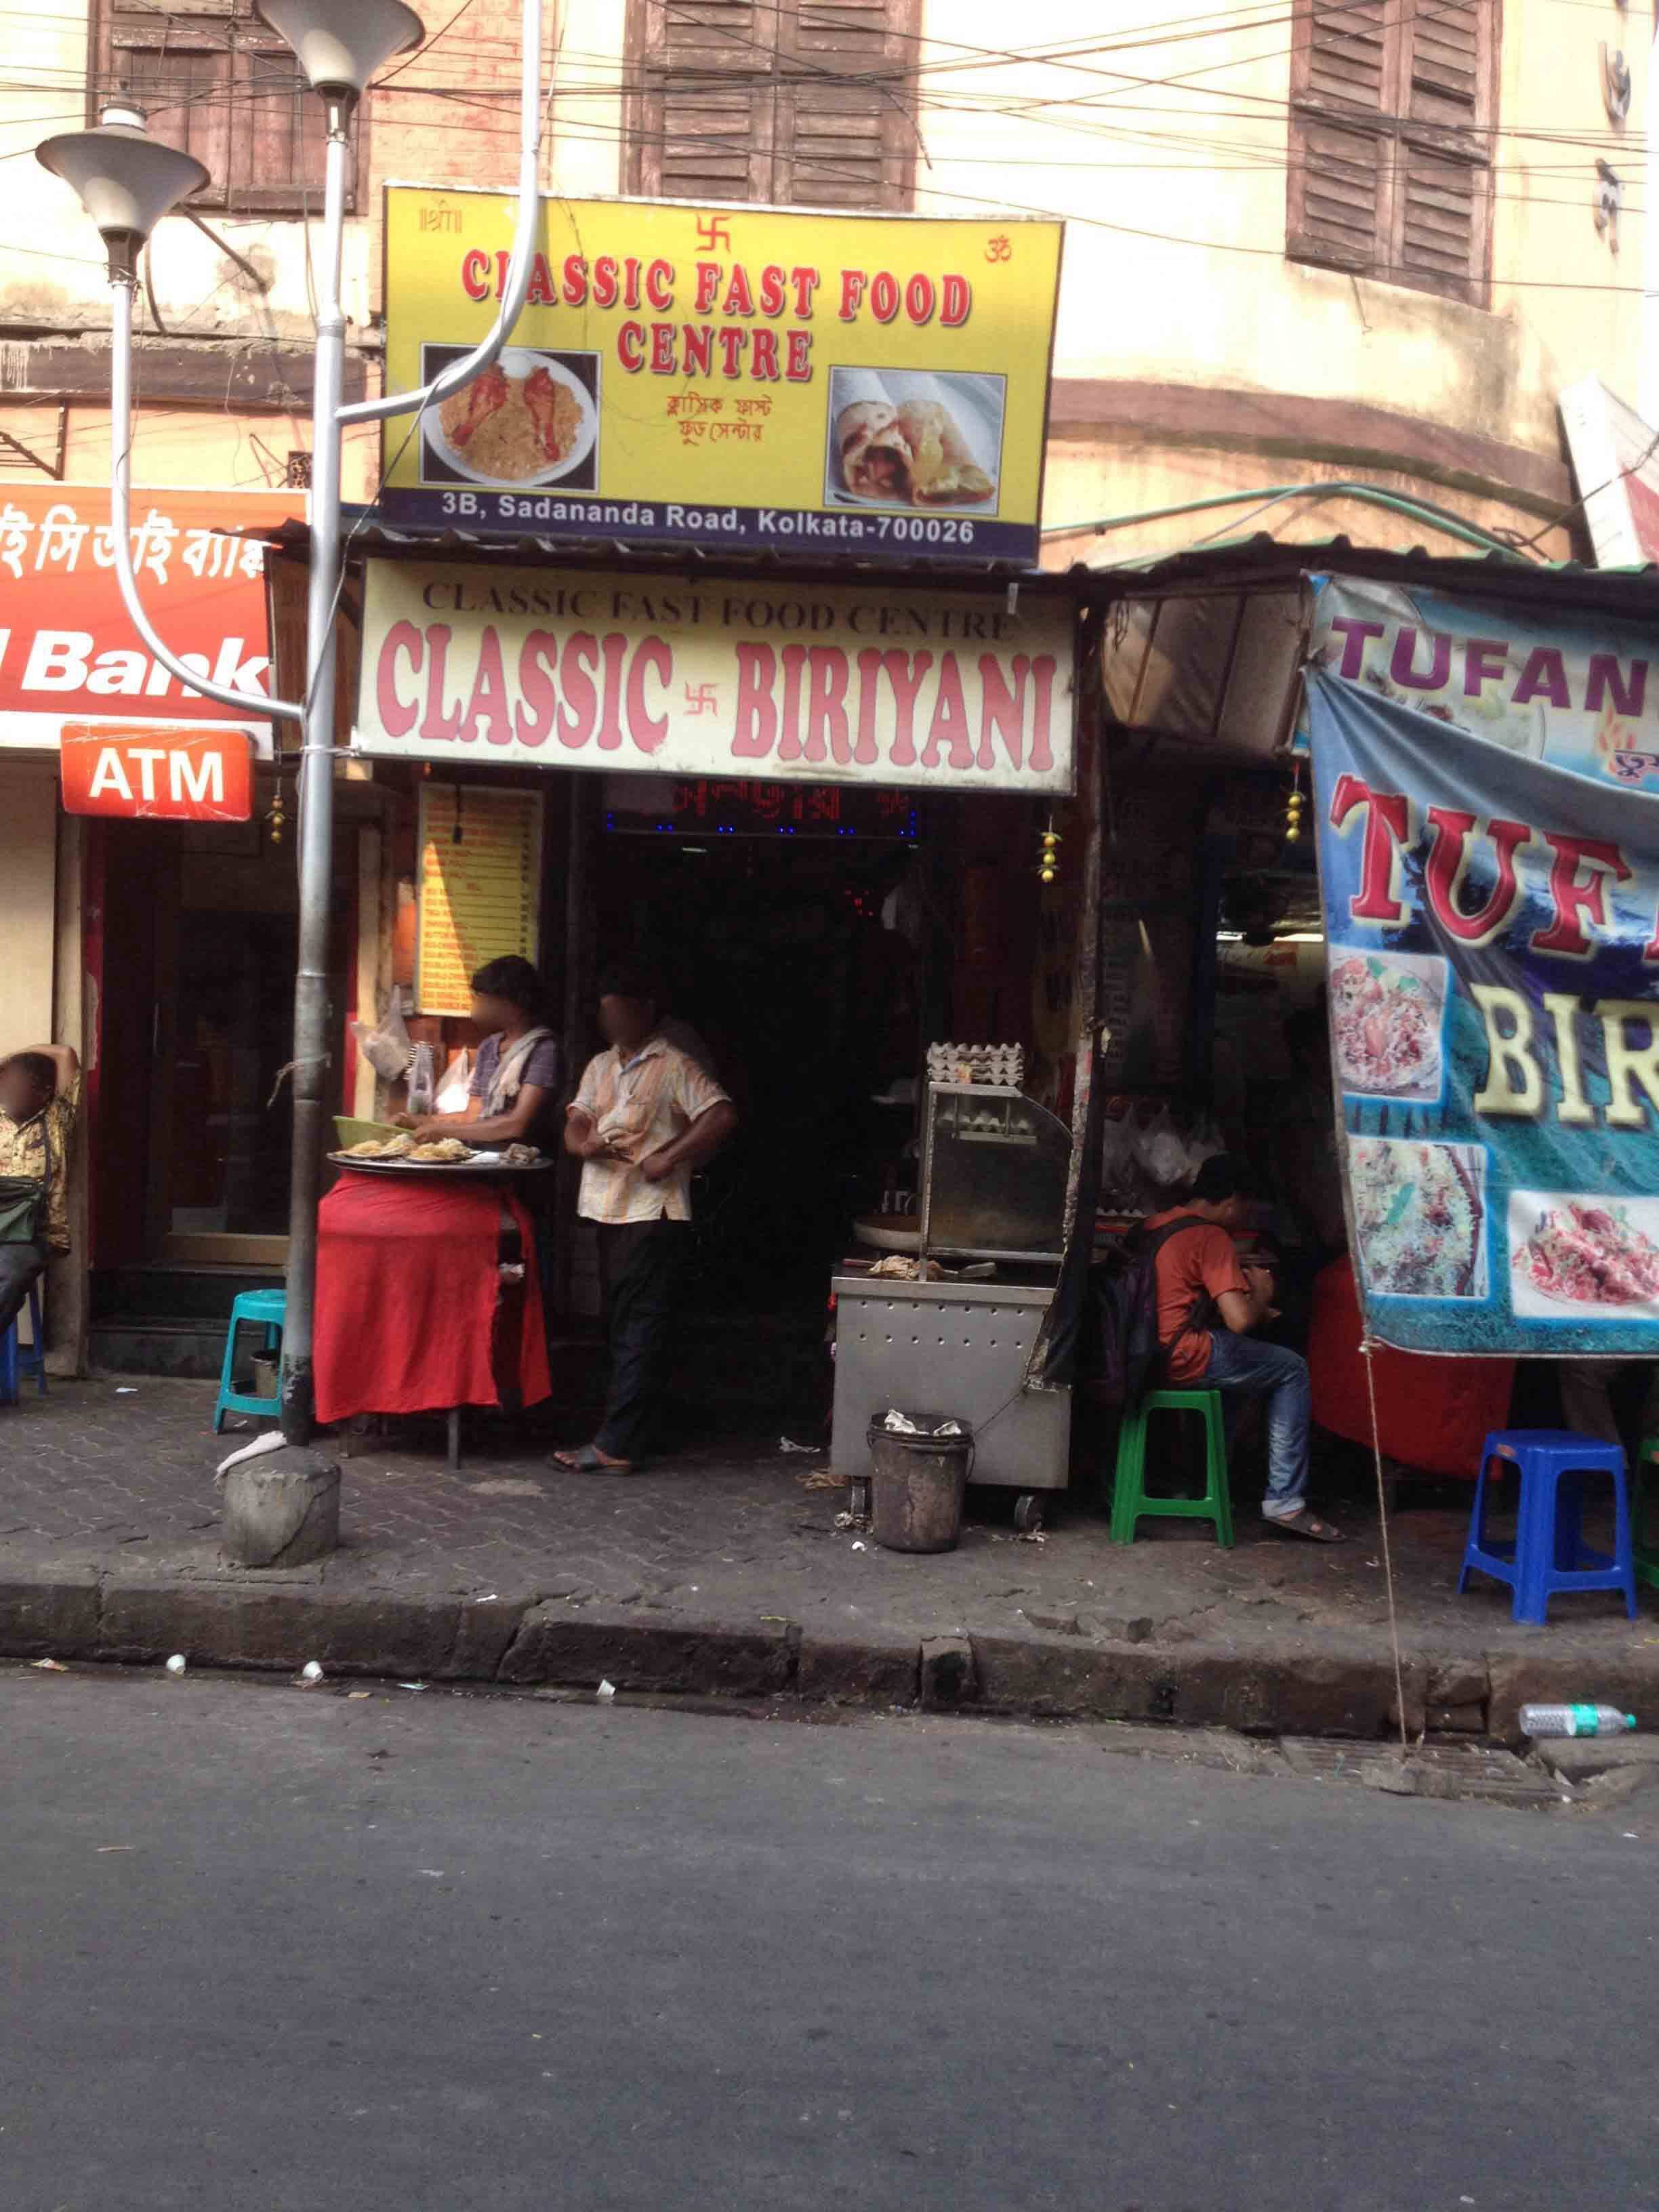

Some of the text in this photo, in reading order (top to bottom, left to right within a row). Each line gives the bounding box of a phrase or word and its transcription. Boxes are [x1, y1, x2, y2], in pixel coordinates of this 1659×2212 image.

[693, 262, 818, 319] FAST
[838, 270, 971, 326] FOOD
[617, 321, 813, 381] CENTRE
[442, 492, 974, 543] 3B, Sadananda Road, Kolkata-700026
[422, 582, 1017, 640] CLASSIC FAST FOOD CENTRE
[21, 628, 270, 697] Bank
[377, 619, 1057, 771] CLASSIC BIRIYANI
[1332, 616, 1649, 717] TUFAN
[89, 747, 224, 802] ATM
[1330, 774, 1659, 960] TUF
[1469, 982, 1659, 1125] BIR
